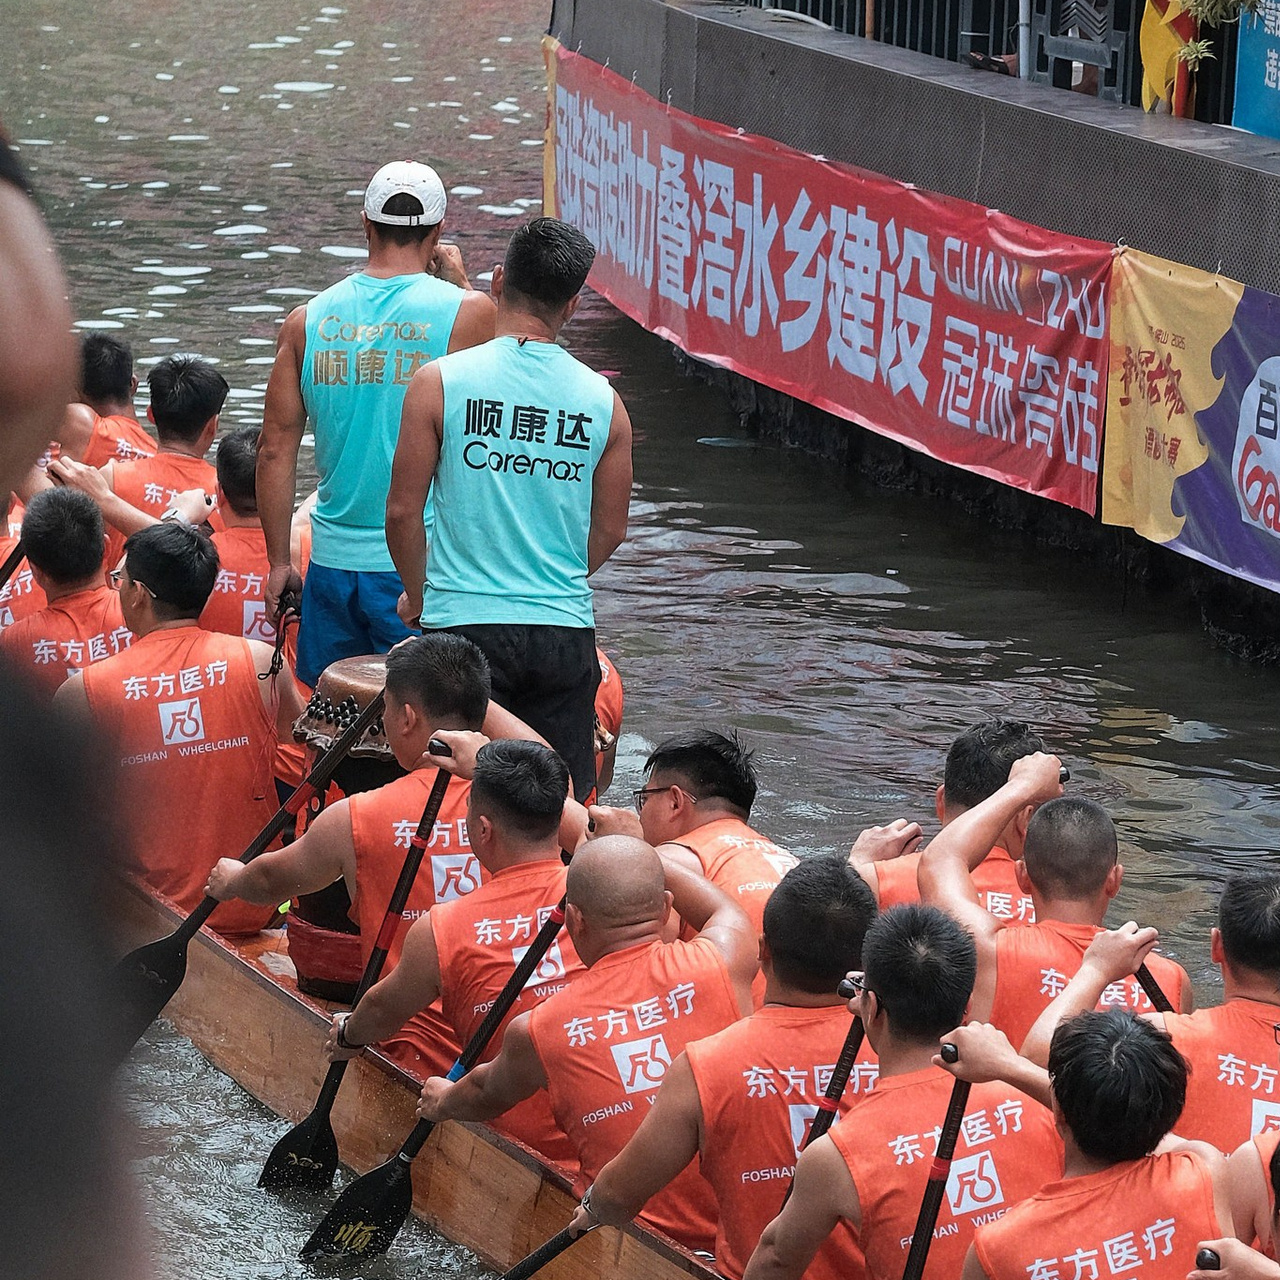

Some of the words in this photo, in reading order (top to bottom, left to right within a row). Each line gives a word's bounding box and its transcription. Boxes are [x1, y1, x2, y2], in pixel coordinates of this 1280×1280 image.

[318, 315, 432, 344] Coremax
[313, 348, 430, 388] 顺康达
[937, 317, 1099, 474] 冠珠瓷砖
[463, 398, 592, 450] 顺康达
[463, 440, 586, 484] Coremax
[214, 567, 269, 597] 东方
[32, 626, 134, 665] 东方医疗
[122, 659, 228, 702] 东方医疗
[120, 749, 168, 767] FOSHAN
[178, 735, 250, 757] WHEELCHAIR
[979, 891, 1035, 923] 医疗
[1040, 967, 1153, 1009] 东医疗
[563, 981, 695, 1048] 东方医疗
[743, 1061, 880, 1099] 东方医疗
[582, 1100, 633, 1126] FOSHAN
[888, 1099, 1024, 1166] 东方医疗
